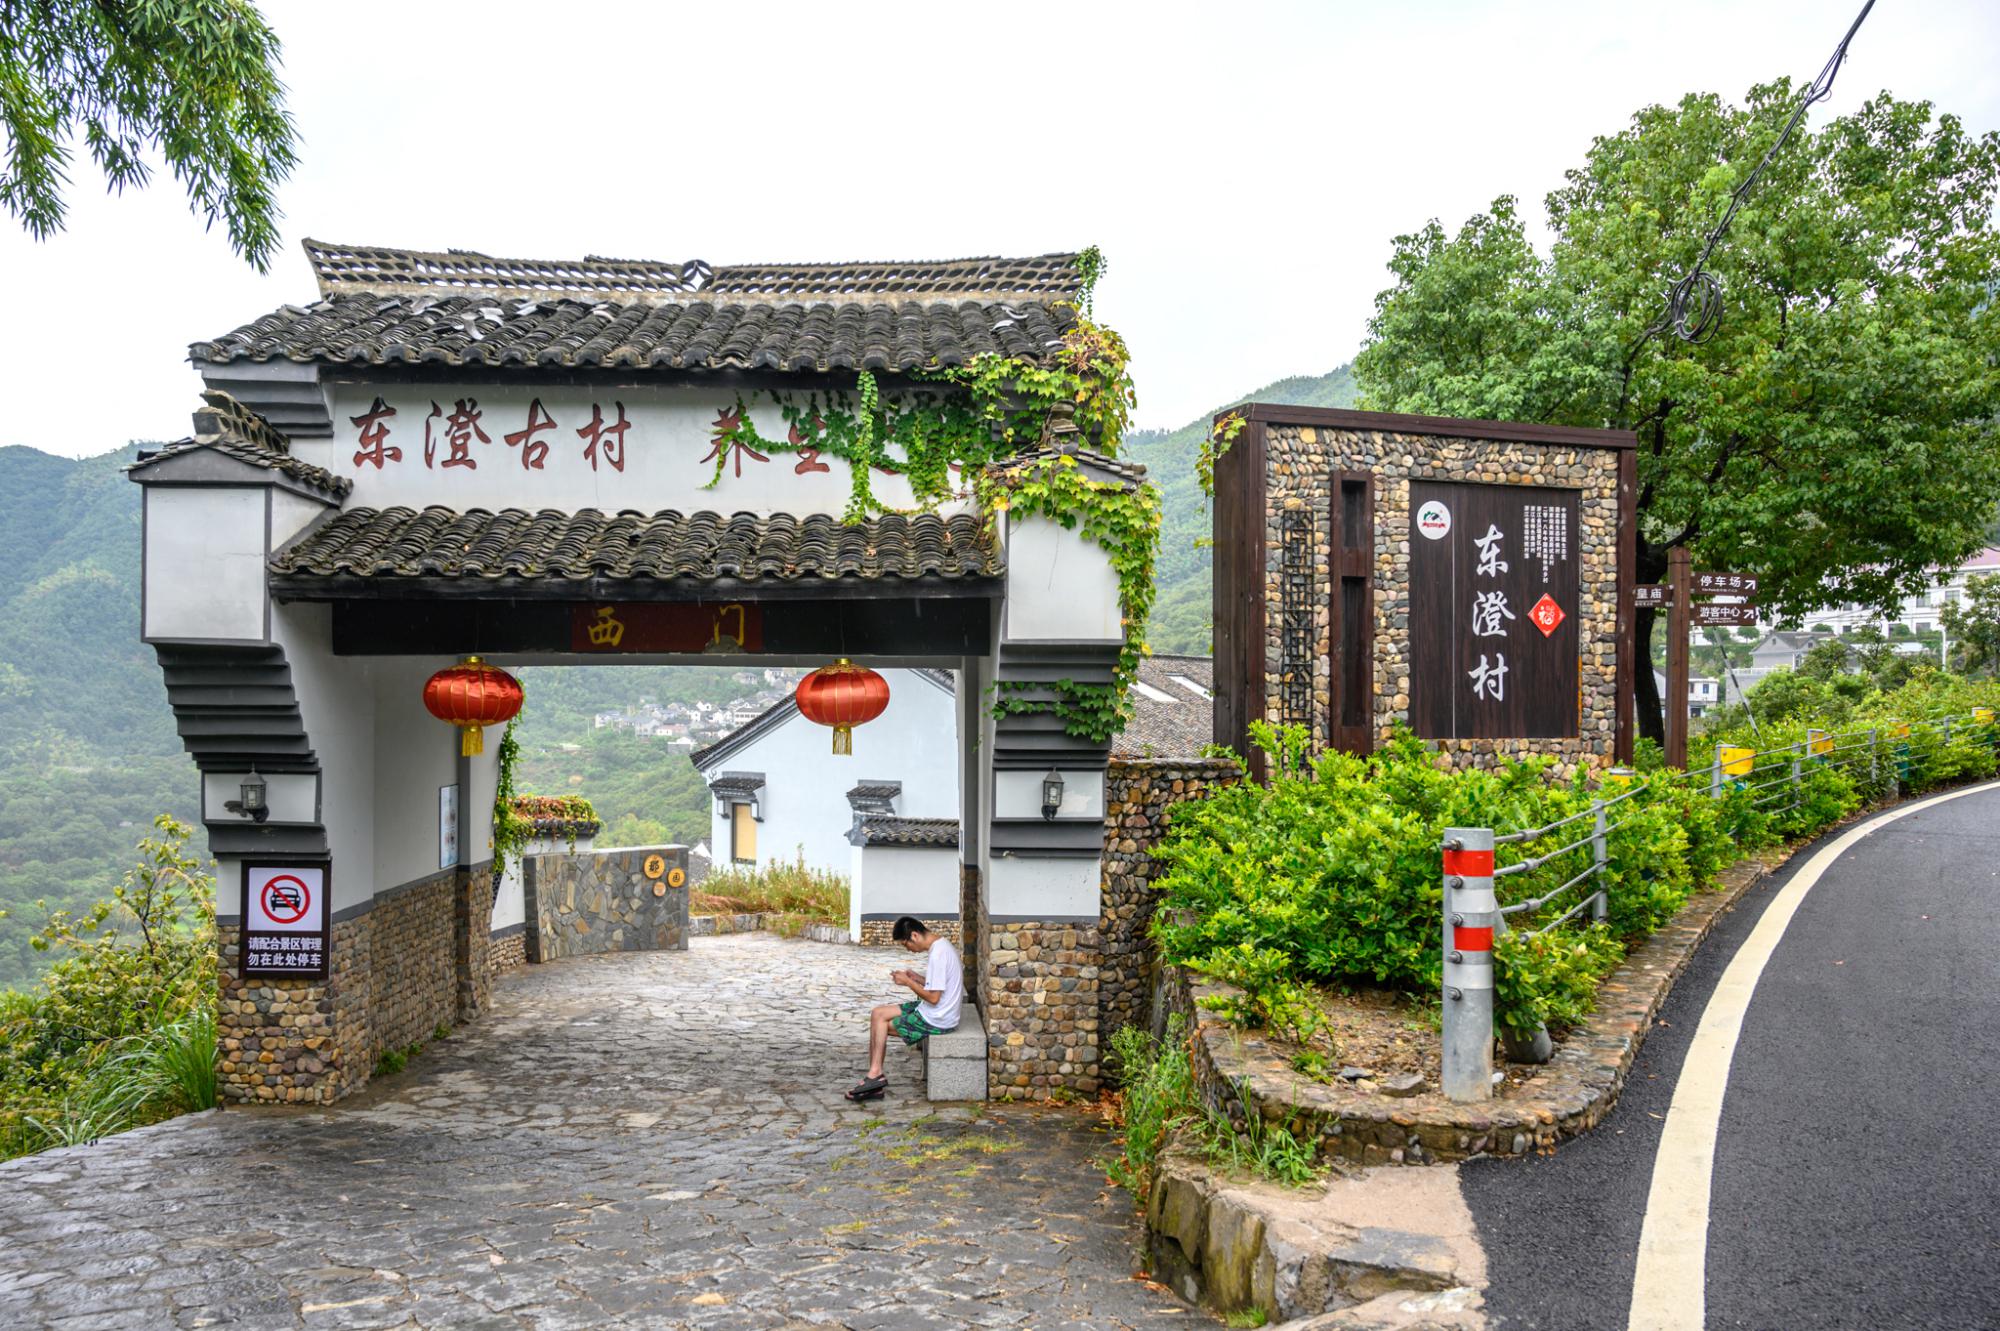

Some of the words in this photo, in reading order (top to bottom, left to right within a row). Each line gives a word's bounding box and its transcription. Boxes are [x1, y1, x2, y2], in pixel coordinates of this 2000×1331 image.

[350, 396, 632, 474] 东澄古村
[1700, 575, 1741, 588] 停车场
[1468, 523, 1517, 702] 东澄村
[1700, 606, 1741, 618] 游客中心
[586, 604, 746, 648] 西门
[248, 937, 322, 950] 请配合景区管理
[248, 953, 322, 966] 勿在此处停车
